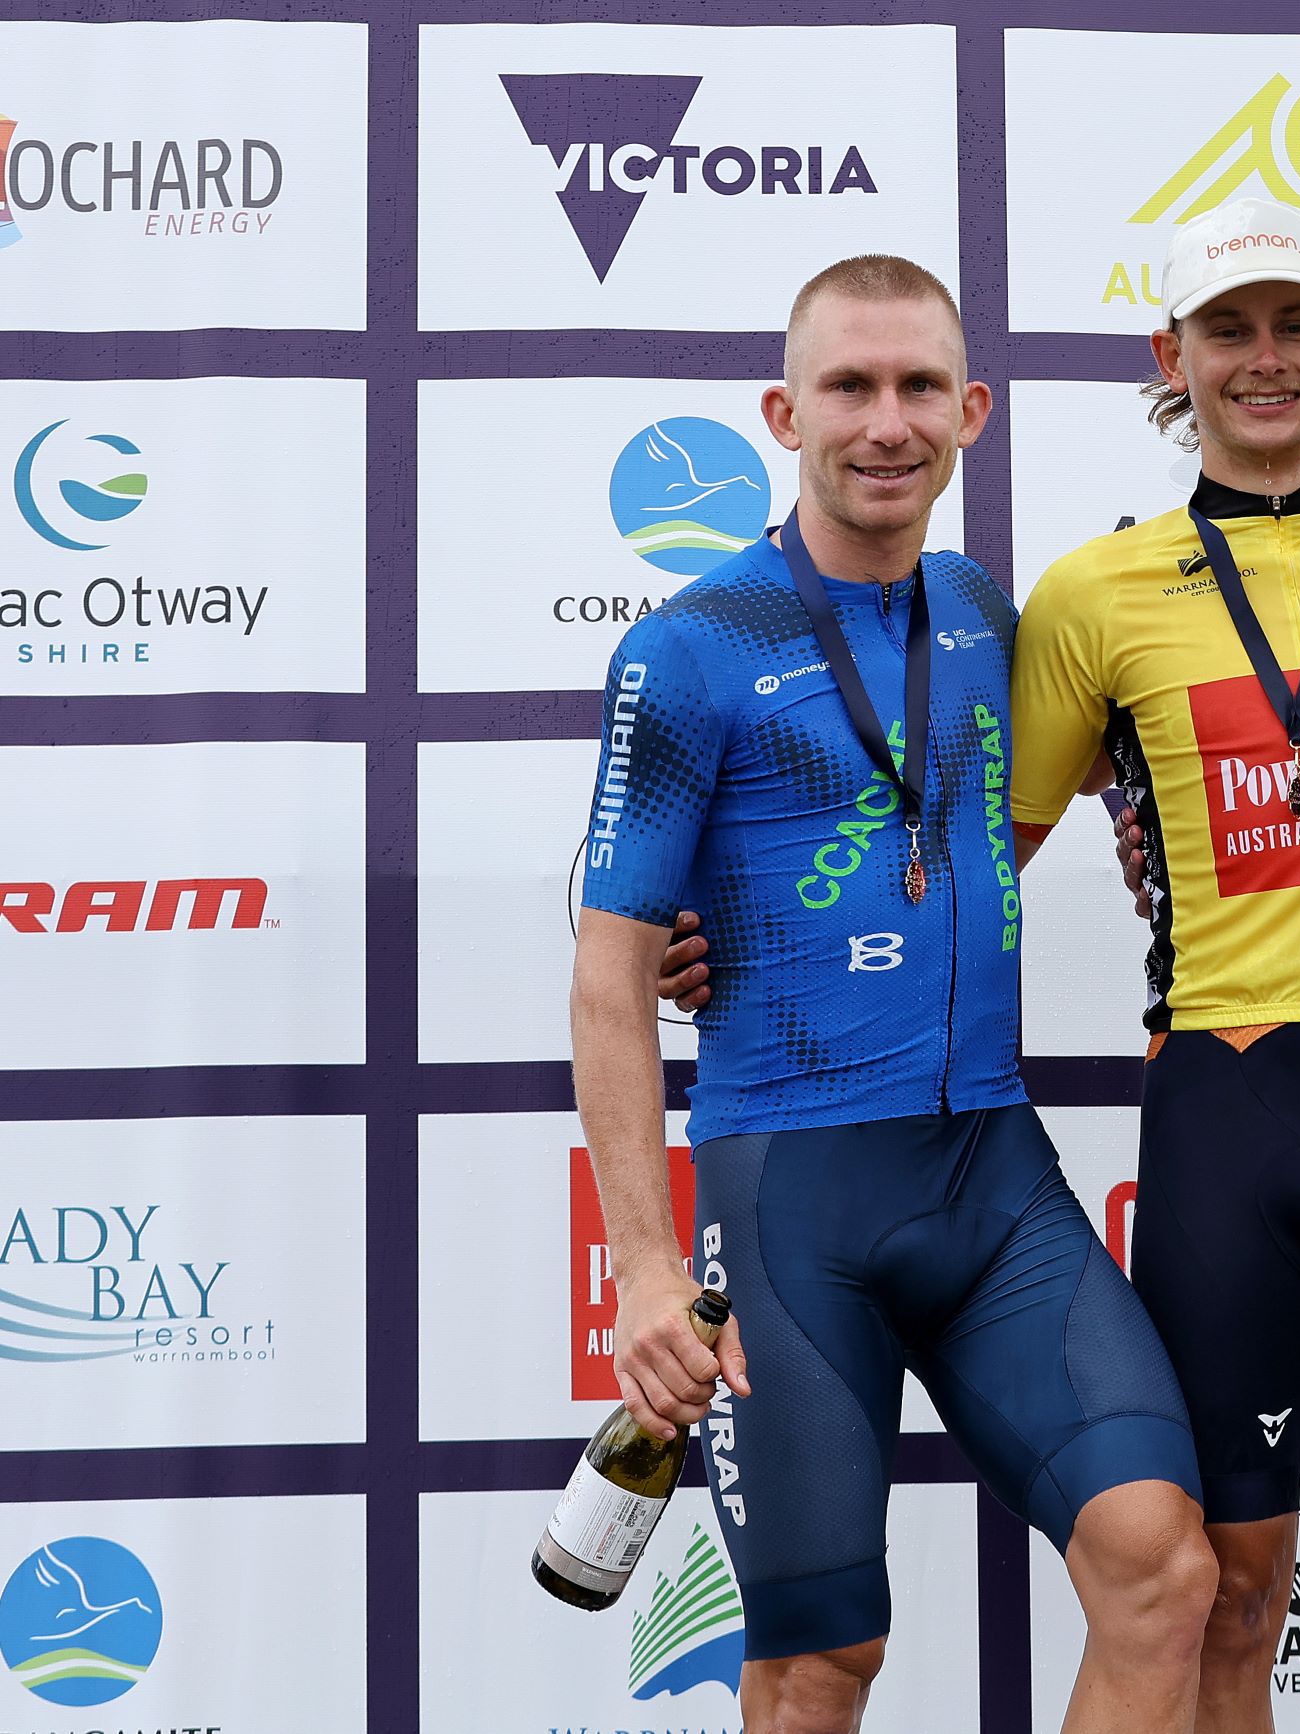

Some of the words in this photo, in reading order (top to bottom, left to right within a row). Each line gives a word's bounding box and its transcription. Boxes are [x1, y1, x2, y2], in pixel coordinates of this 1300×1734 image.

[0, 139, 283, 212] OCHARD
[532, 142, 879, 196] VICTORIA
[145, 212, 272, 236] ENERGY
[83, 576, 269, 636] Otway
[953, 628, 966, 636] UCI
[17, 643, 150, 664] SHIRE
[956, 630, 995, 643] CONTINENTAL
[959, 641, 976, 650] TEAM
[591, 662, 647, 870] SHIMANO
[974, 704, 1021, 952] BODYWRAP
[0, 877, 269, 933] RAM
[0, 1205, 160, 1264] ADY
[88, 1262, 231, 1321] BAY
[133, 1348, 275, 1362] warrnambool
[135, 1320, 275, 1347] resort
[701, 1222, 747, 1527] BOWRAP
